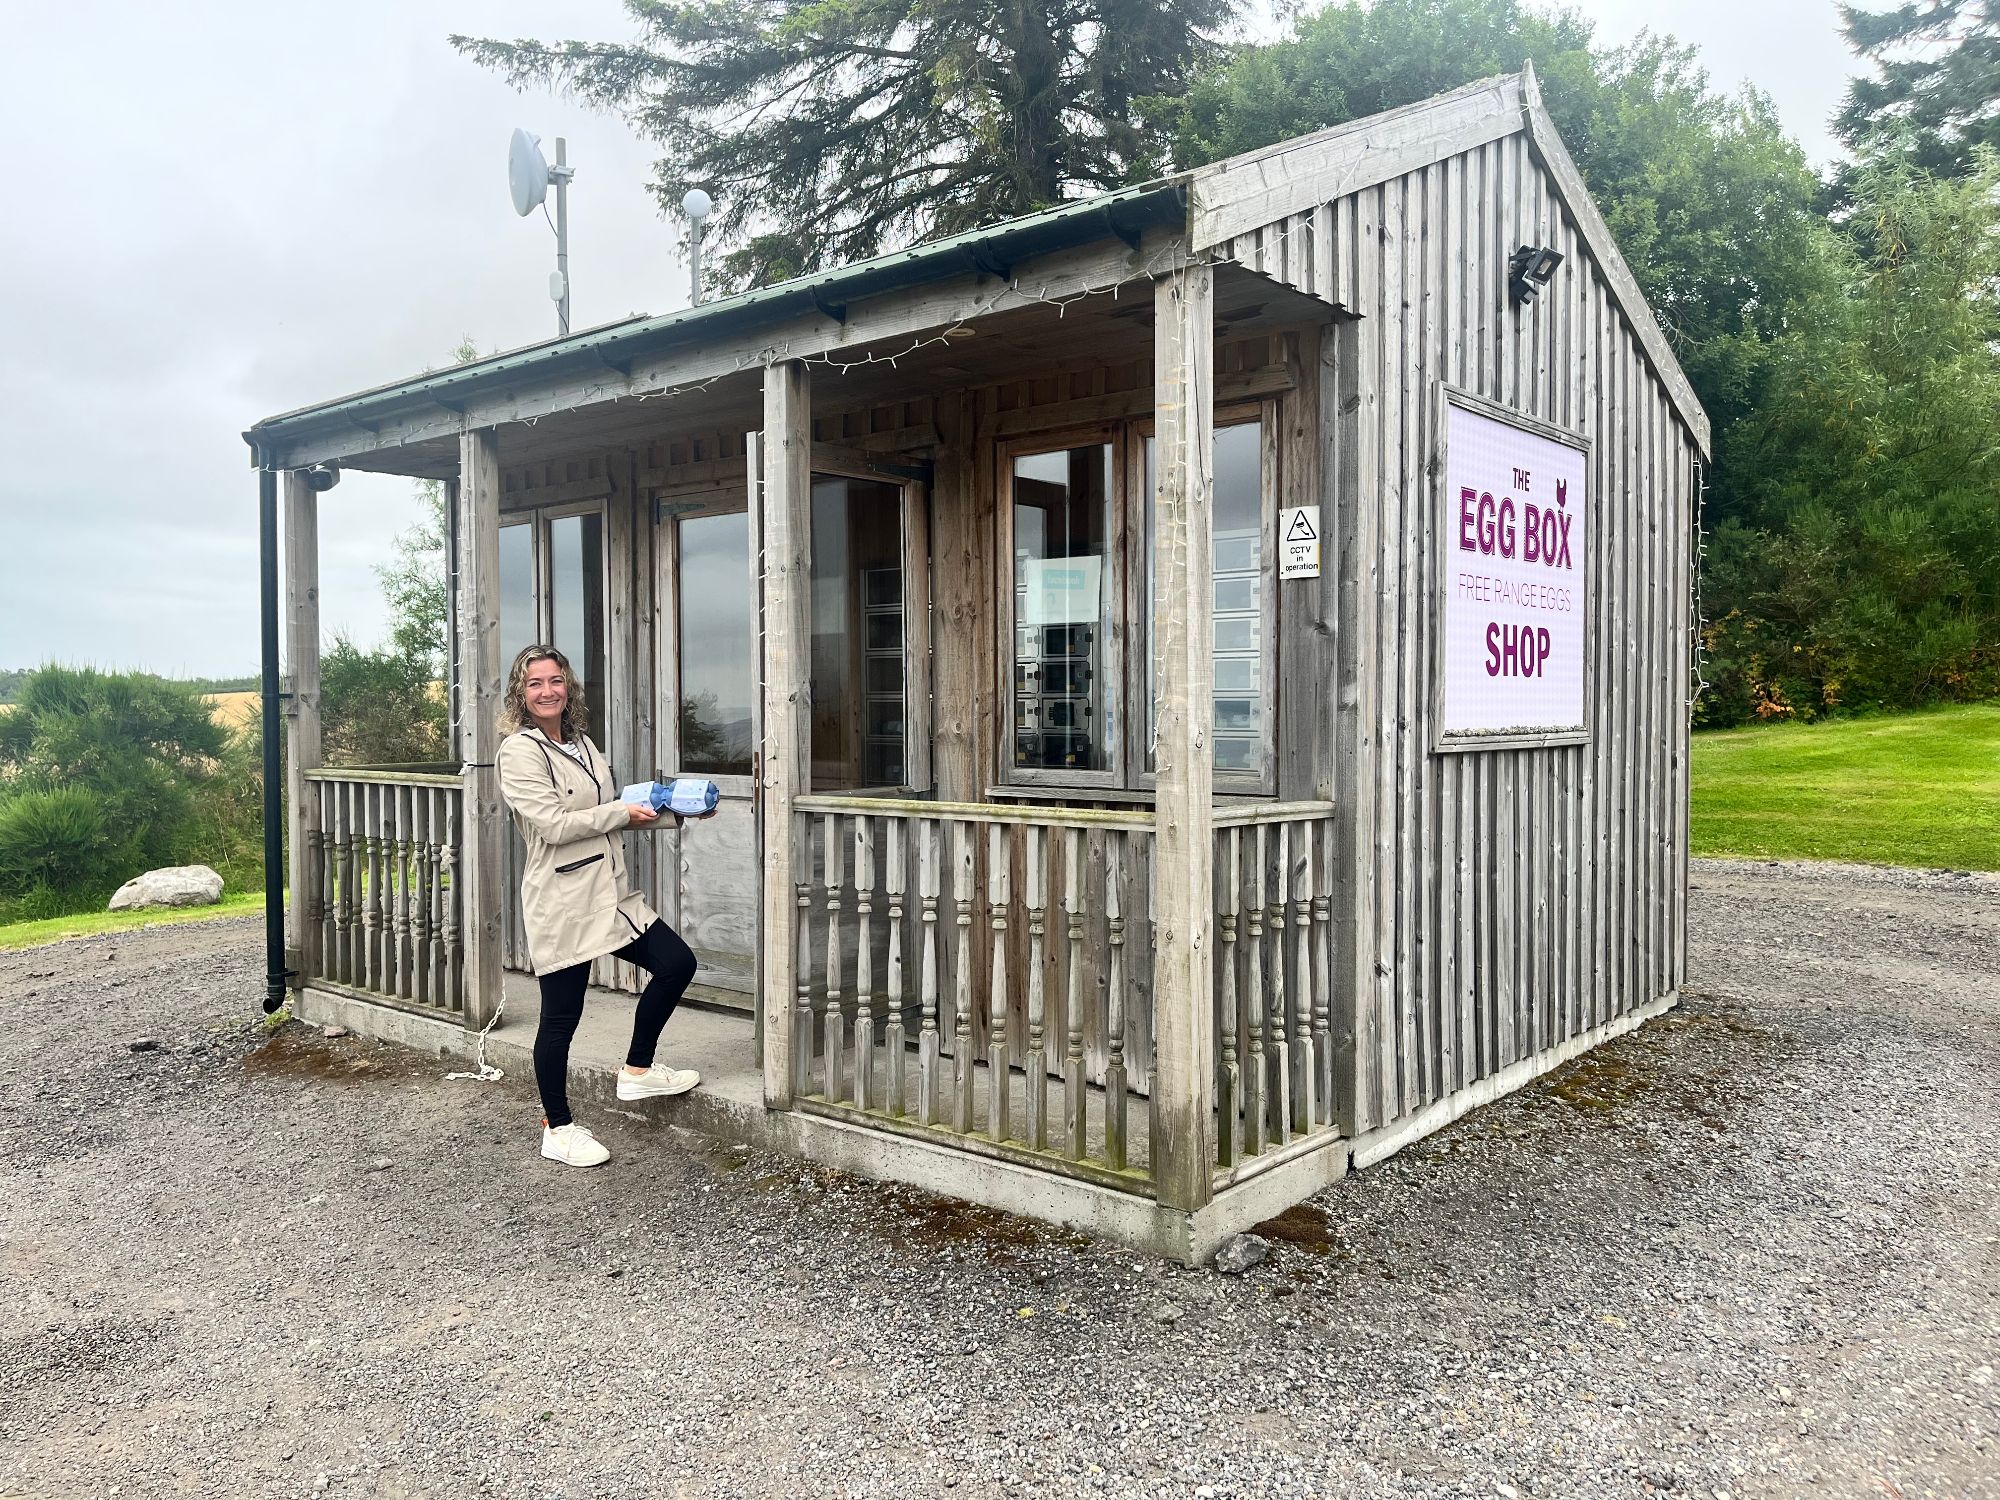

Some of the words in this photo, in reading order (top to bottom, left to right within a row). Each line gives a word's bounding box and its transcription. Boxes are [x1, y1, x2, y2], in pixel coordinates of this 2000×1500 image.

[1513, 467, 1530, 492] THE
[1460, 486, 1516, 559] EGG
[1524, 502, 1572, 569] BOX
[1290, 546, 1311, 554] CCTV
[1285, 562, 1318, 572] operation
[1459, 573, 1491, 602] FREE
[1495, 578, 1537, 608] RANGE
[1541, 586, 1571, 612] EGGS
[1485, 621, 1551, 678] SHOP
